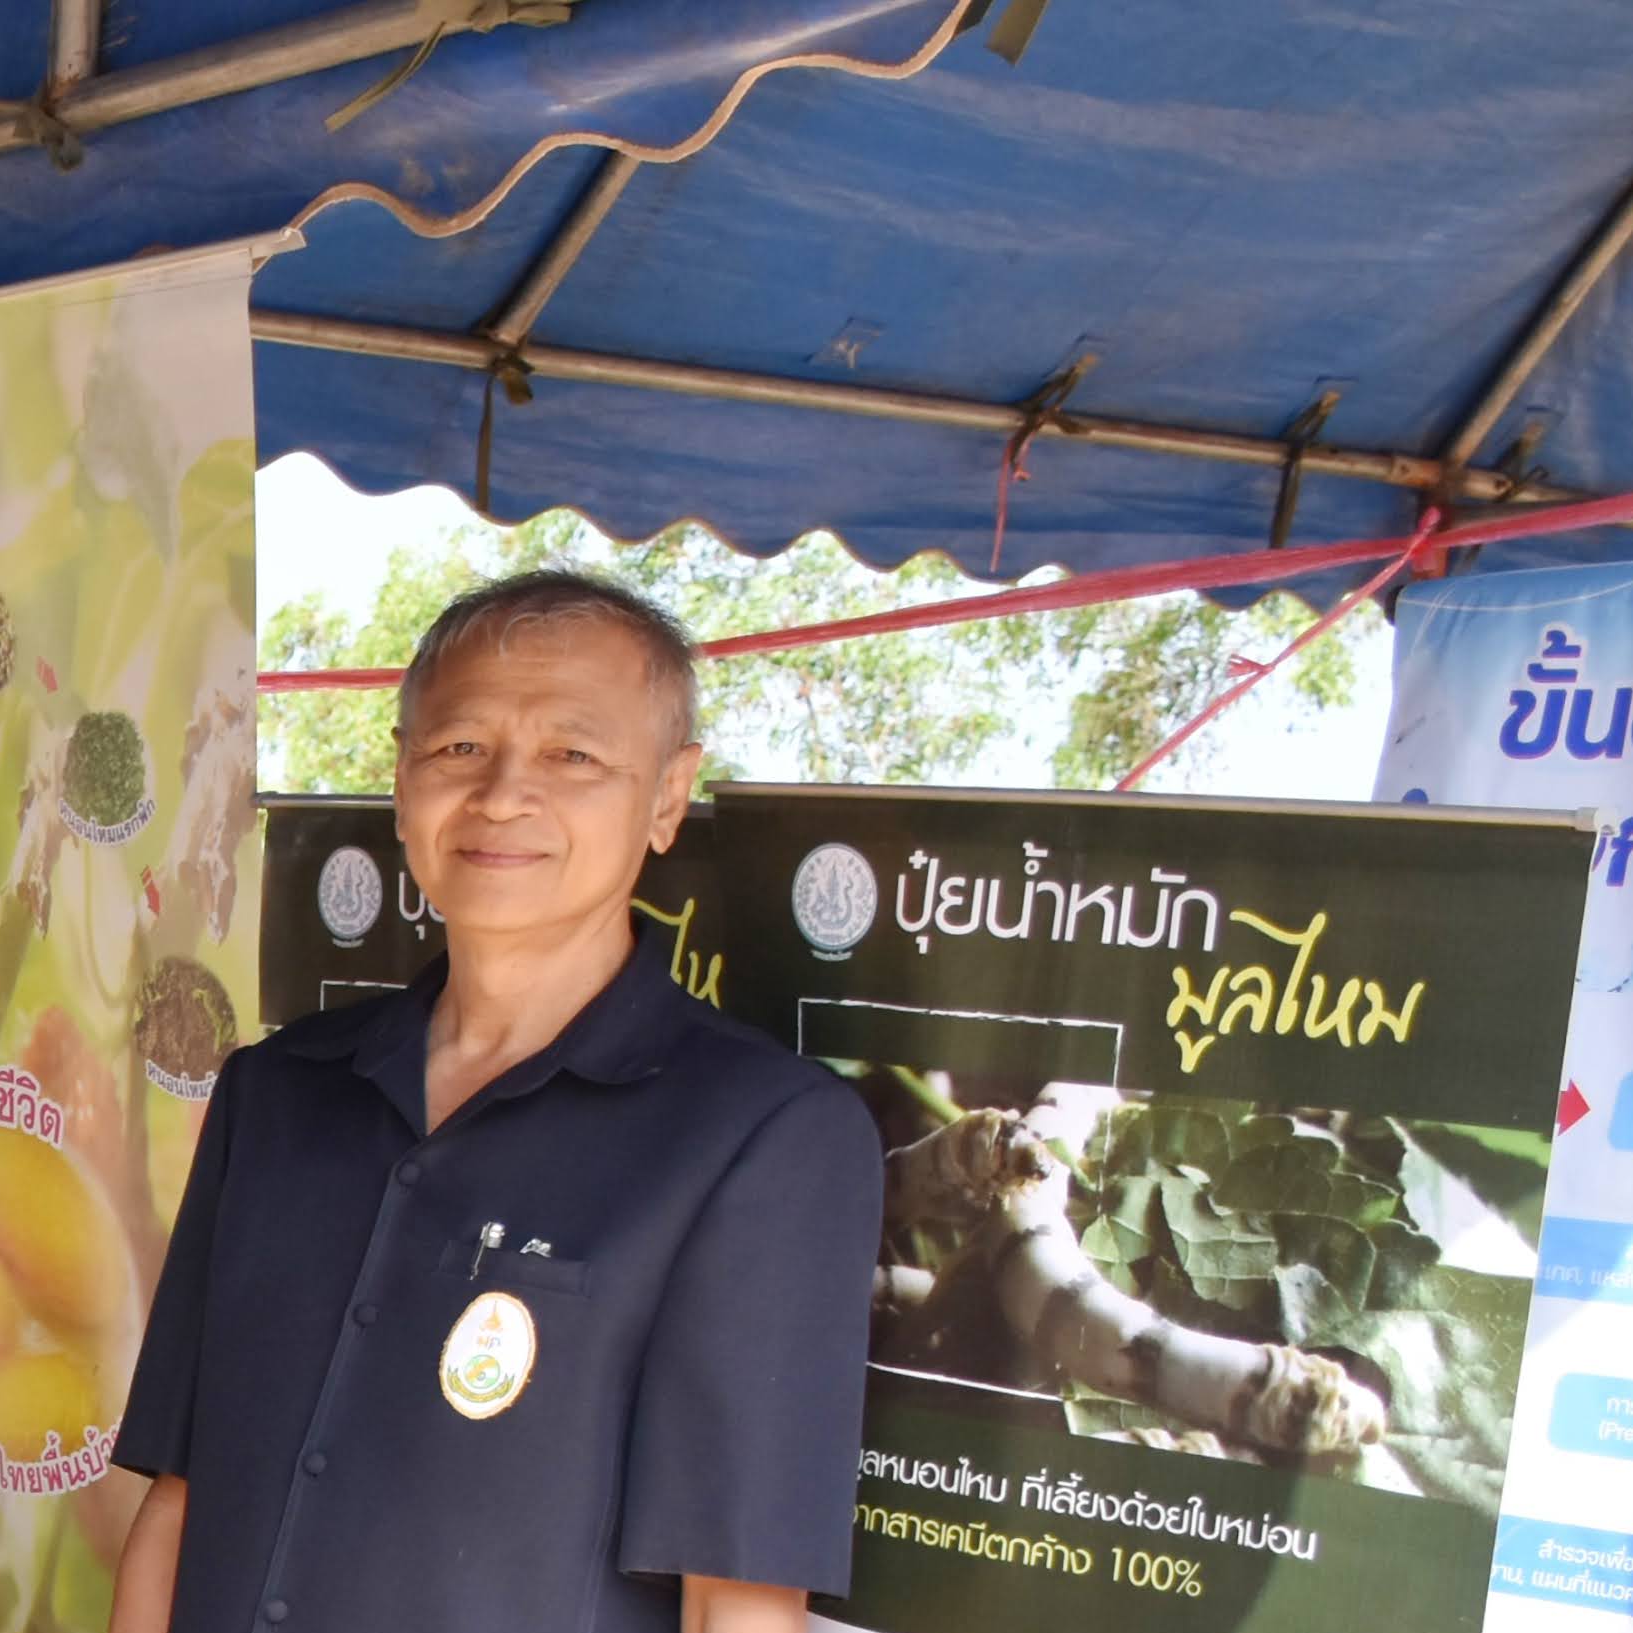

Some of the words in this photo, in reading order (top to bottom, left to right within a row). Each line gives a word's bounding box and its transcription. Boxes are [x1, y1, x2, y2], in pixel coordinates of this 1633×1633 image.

[1499, 628, 1633, 762] ขั้น
[896, 841, 1219, 955] ปุ๋ยน้ำหมัก
[1166, 911, 1426, 1074] มูลไหม
[1021, 1468, 1319, 1561] ที่เลี้ยงด้วยใบหม่อน
[1110, 1546, 1203, 1599] 100%
